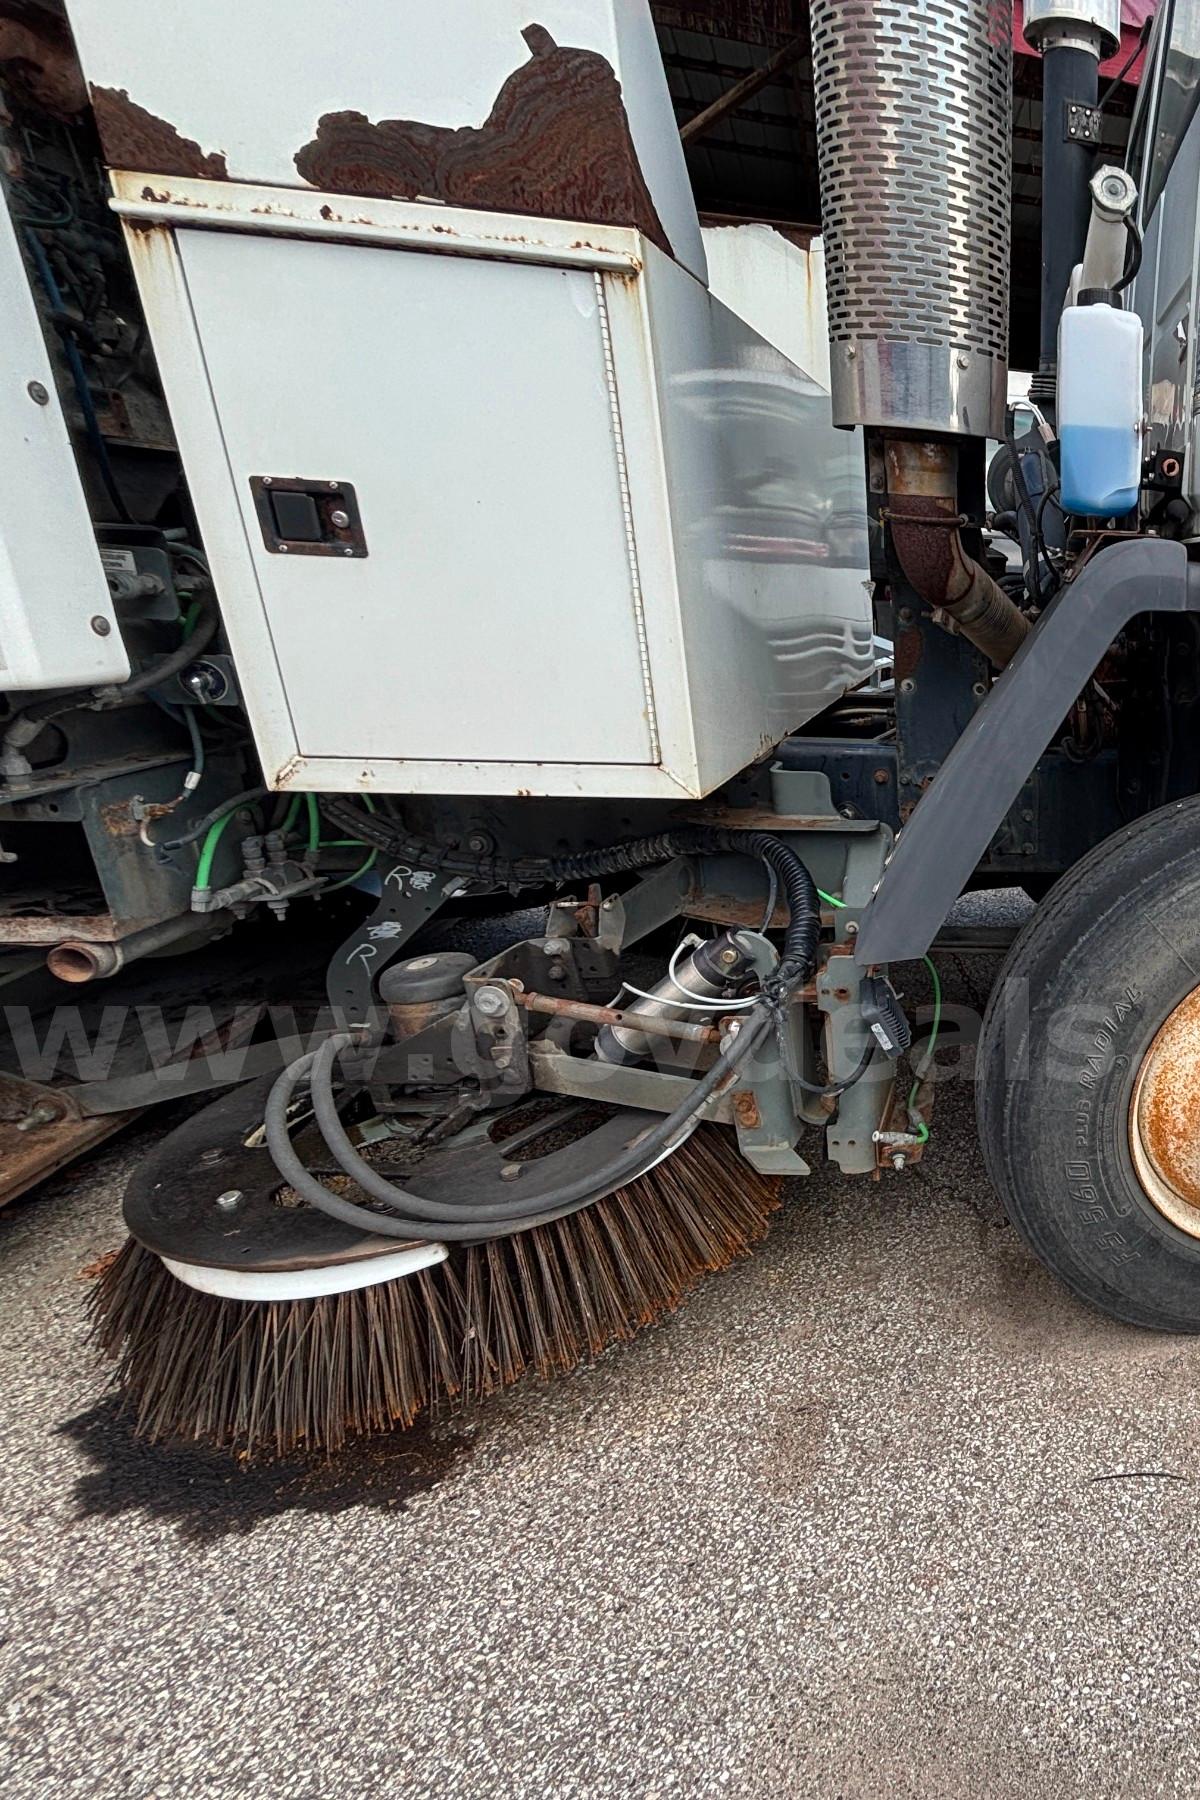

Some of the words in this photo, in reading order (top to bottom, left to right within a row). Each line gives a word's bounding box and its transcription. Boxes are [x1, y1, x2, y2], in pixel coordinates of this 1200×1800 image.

[1079, 981, 1145, 1090] RADIAL
[1075, 1099, 1092, 1150] PLUS
[1064, 1160, 1108, 1226] 560
